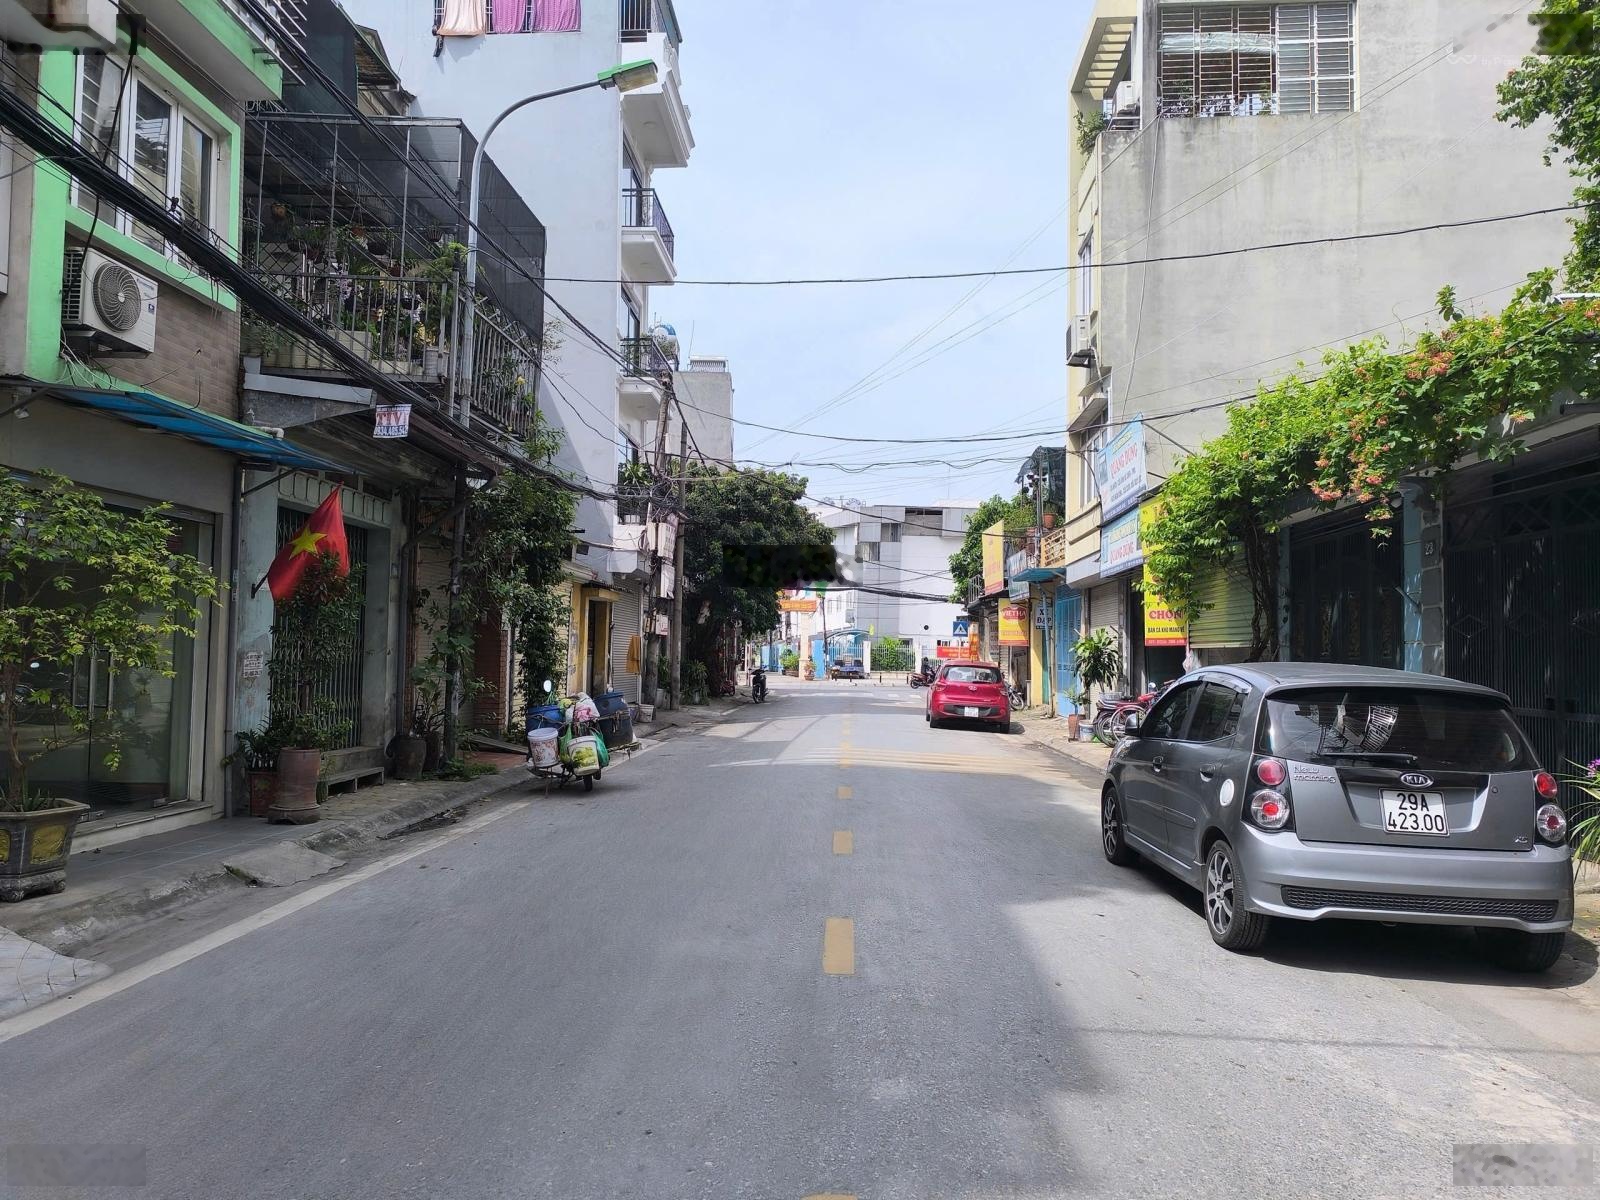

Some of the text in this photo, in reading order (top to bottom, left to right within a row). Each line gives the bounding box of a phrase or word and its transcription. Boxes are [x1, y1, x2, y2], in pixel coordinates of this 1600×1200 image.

[1406, 775, 1426, 784] KIA
[1396, 793, 1430, 812] 29A
[1387, 812, 1445, 832] 423.00
